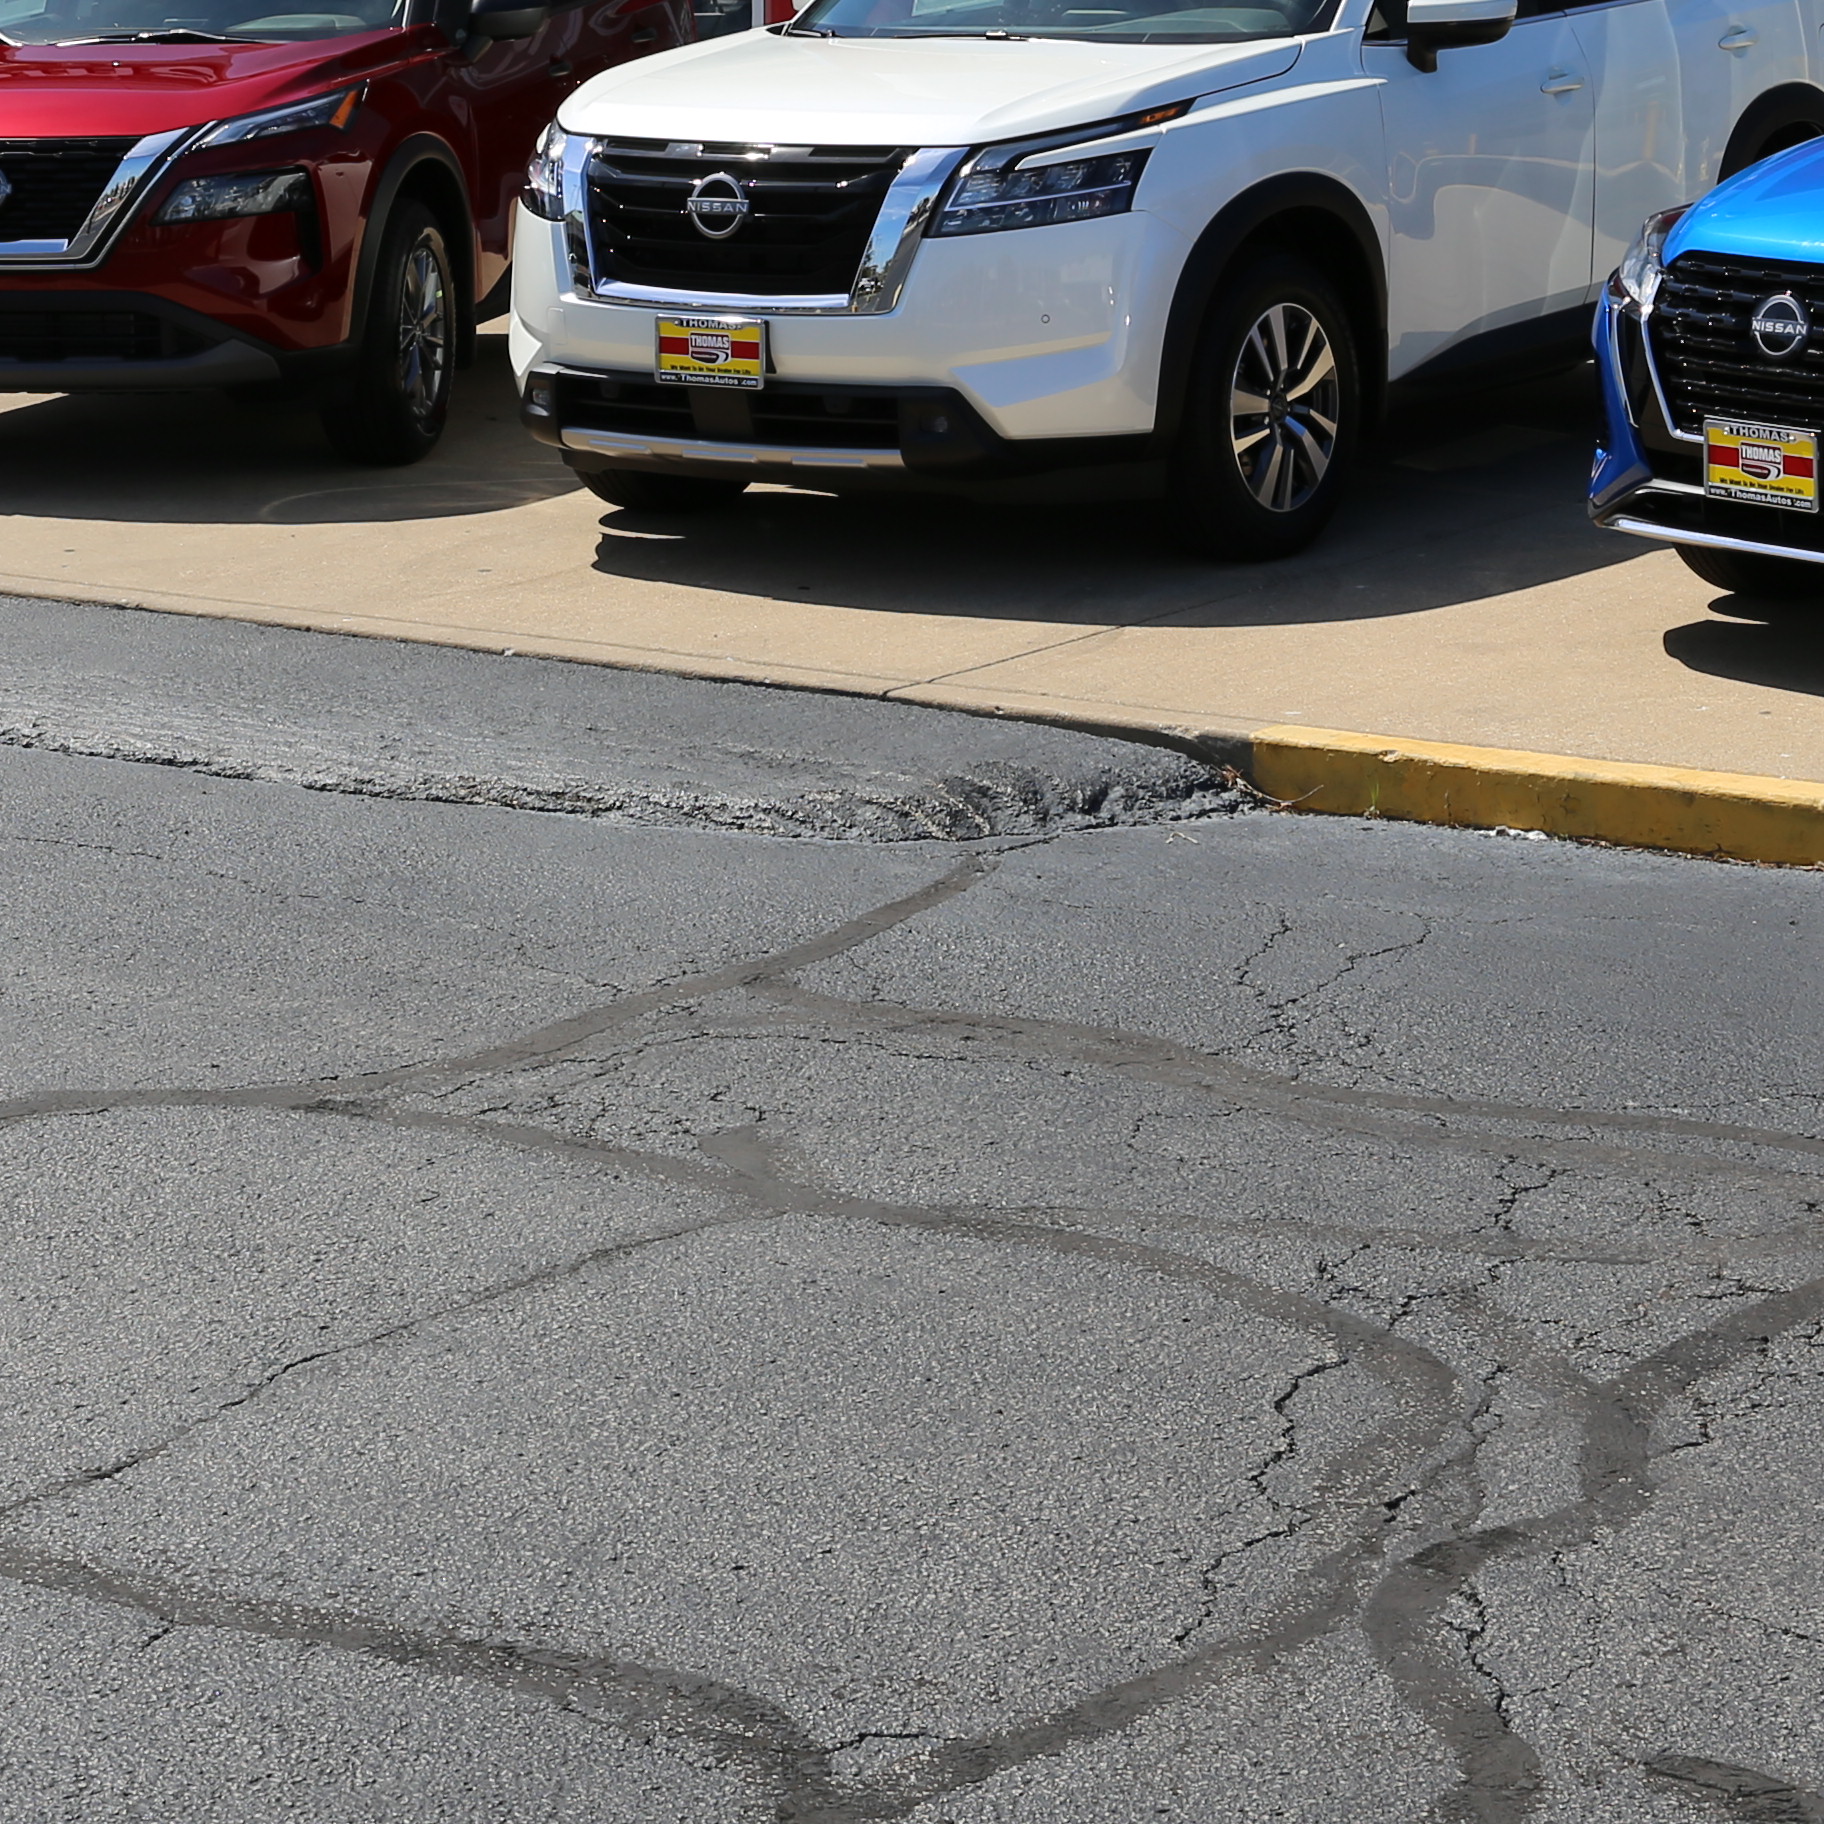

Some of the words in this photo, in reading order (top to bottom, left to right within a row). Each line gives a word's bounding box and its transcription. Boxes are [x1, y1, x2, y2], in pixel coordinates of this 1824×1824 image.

[687, 201, 748, 213] NISSAN
[682, 318, 736, 330] THOMAS
[1751, 320, 1808, 335] NISSAN
[691, 334, 730, 349] THOMAS
[1731, 425, 1788, 443] THOMAS
[1741, 444, 1781, 463] THOMAS
